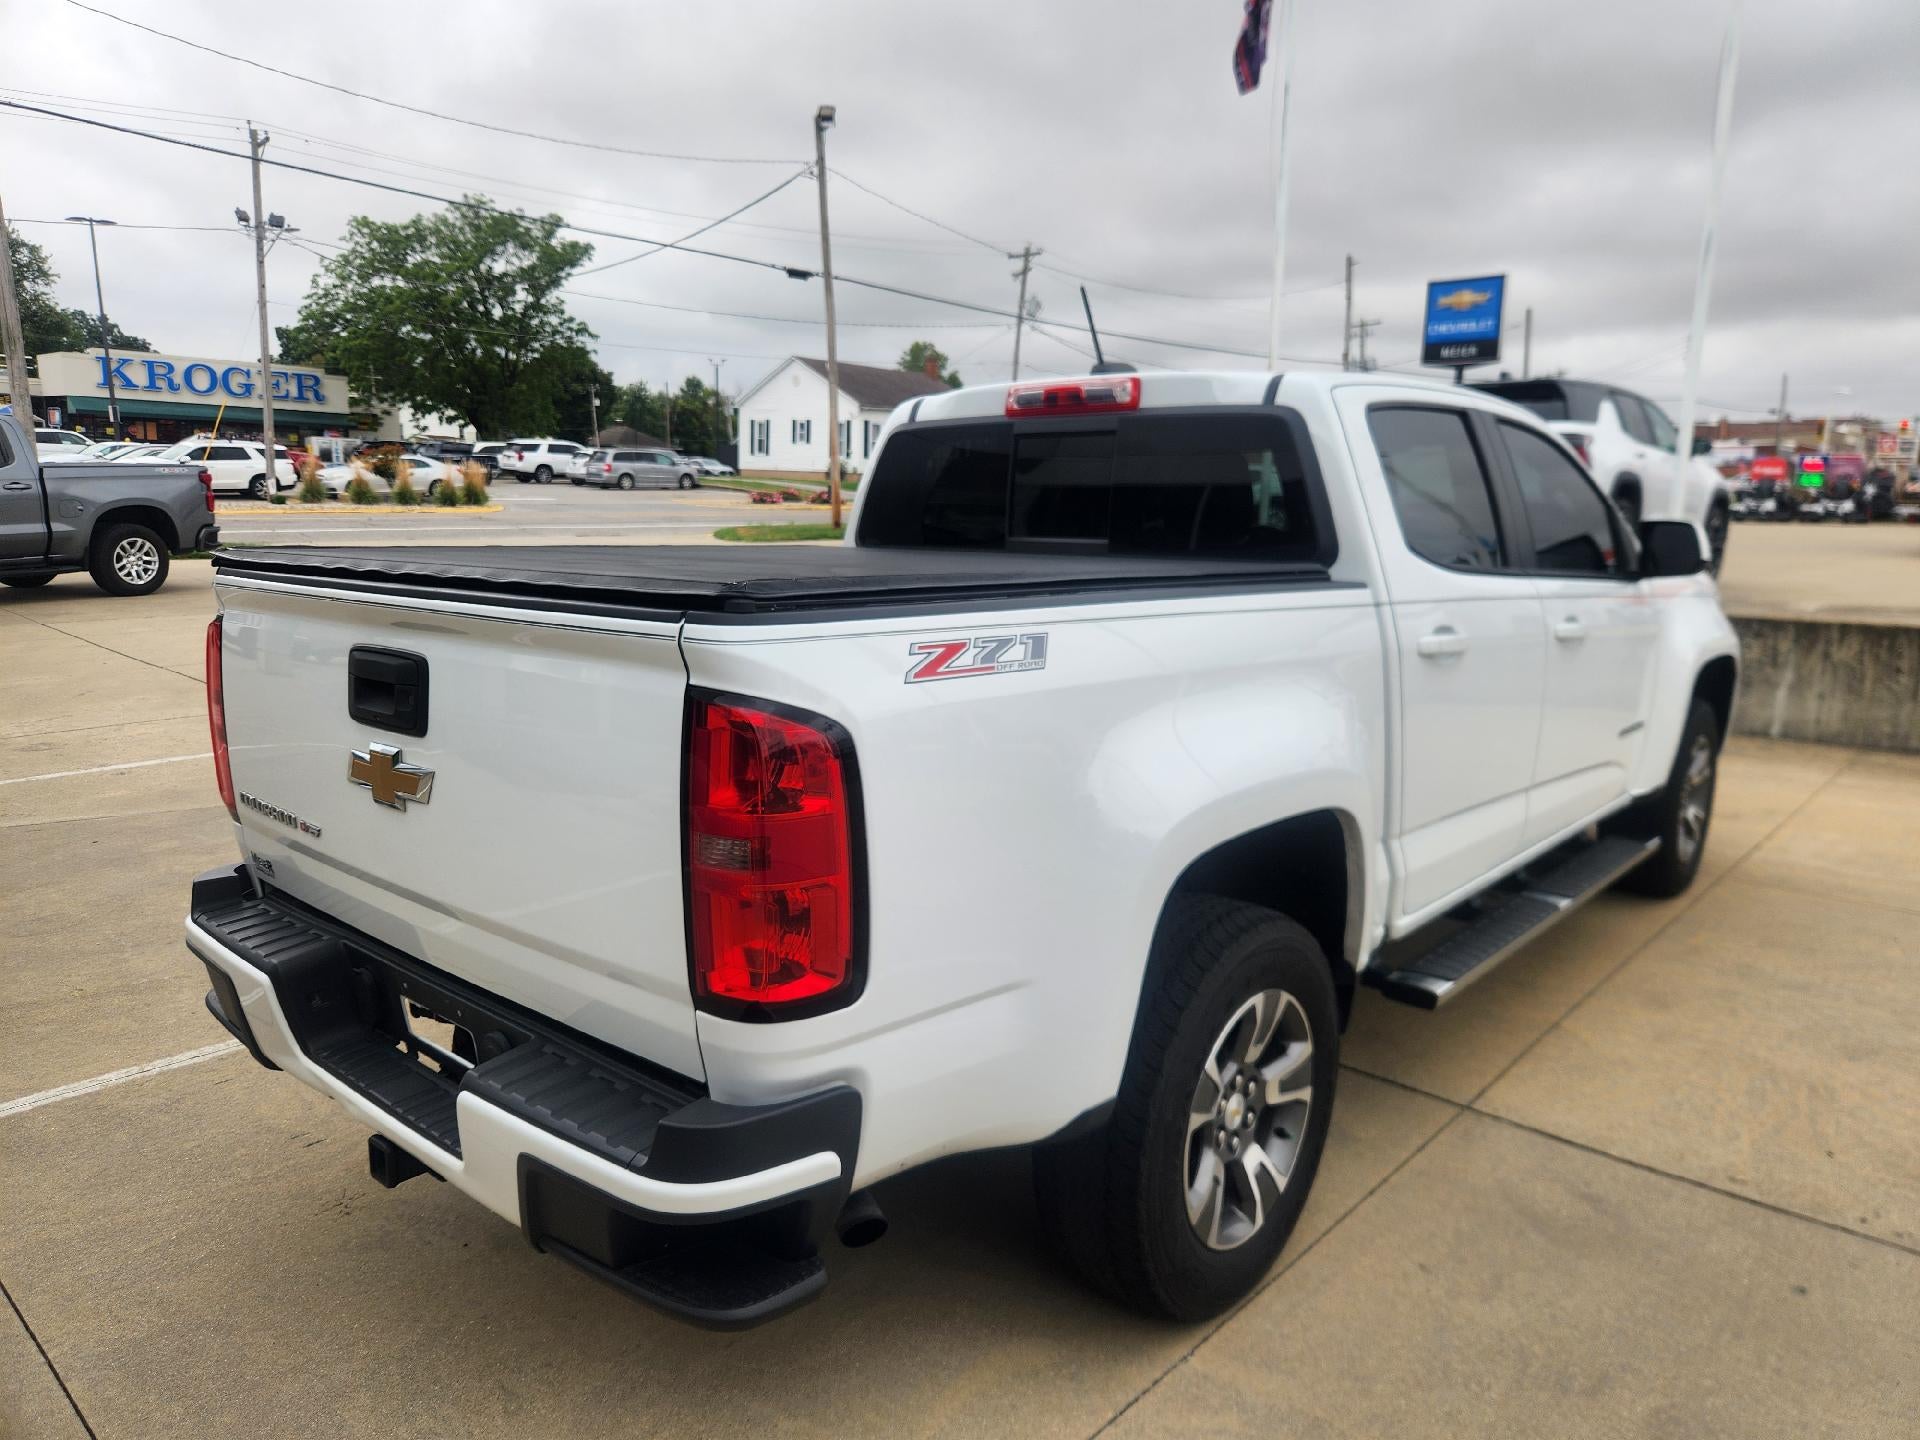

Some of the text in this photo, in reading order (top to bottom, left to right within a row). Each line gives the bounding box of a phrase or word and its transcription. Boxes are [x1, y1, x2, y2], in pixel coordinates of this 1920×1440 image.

[95, 356, 326, 404] KROGER
[904, 633, 1048, 684] Z71
[996, 660, 1044, 672] OFF ROAD
